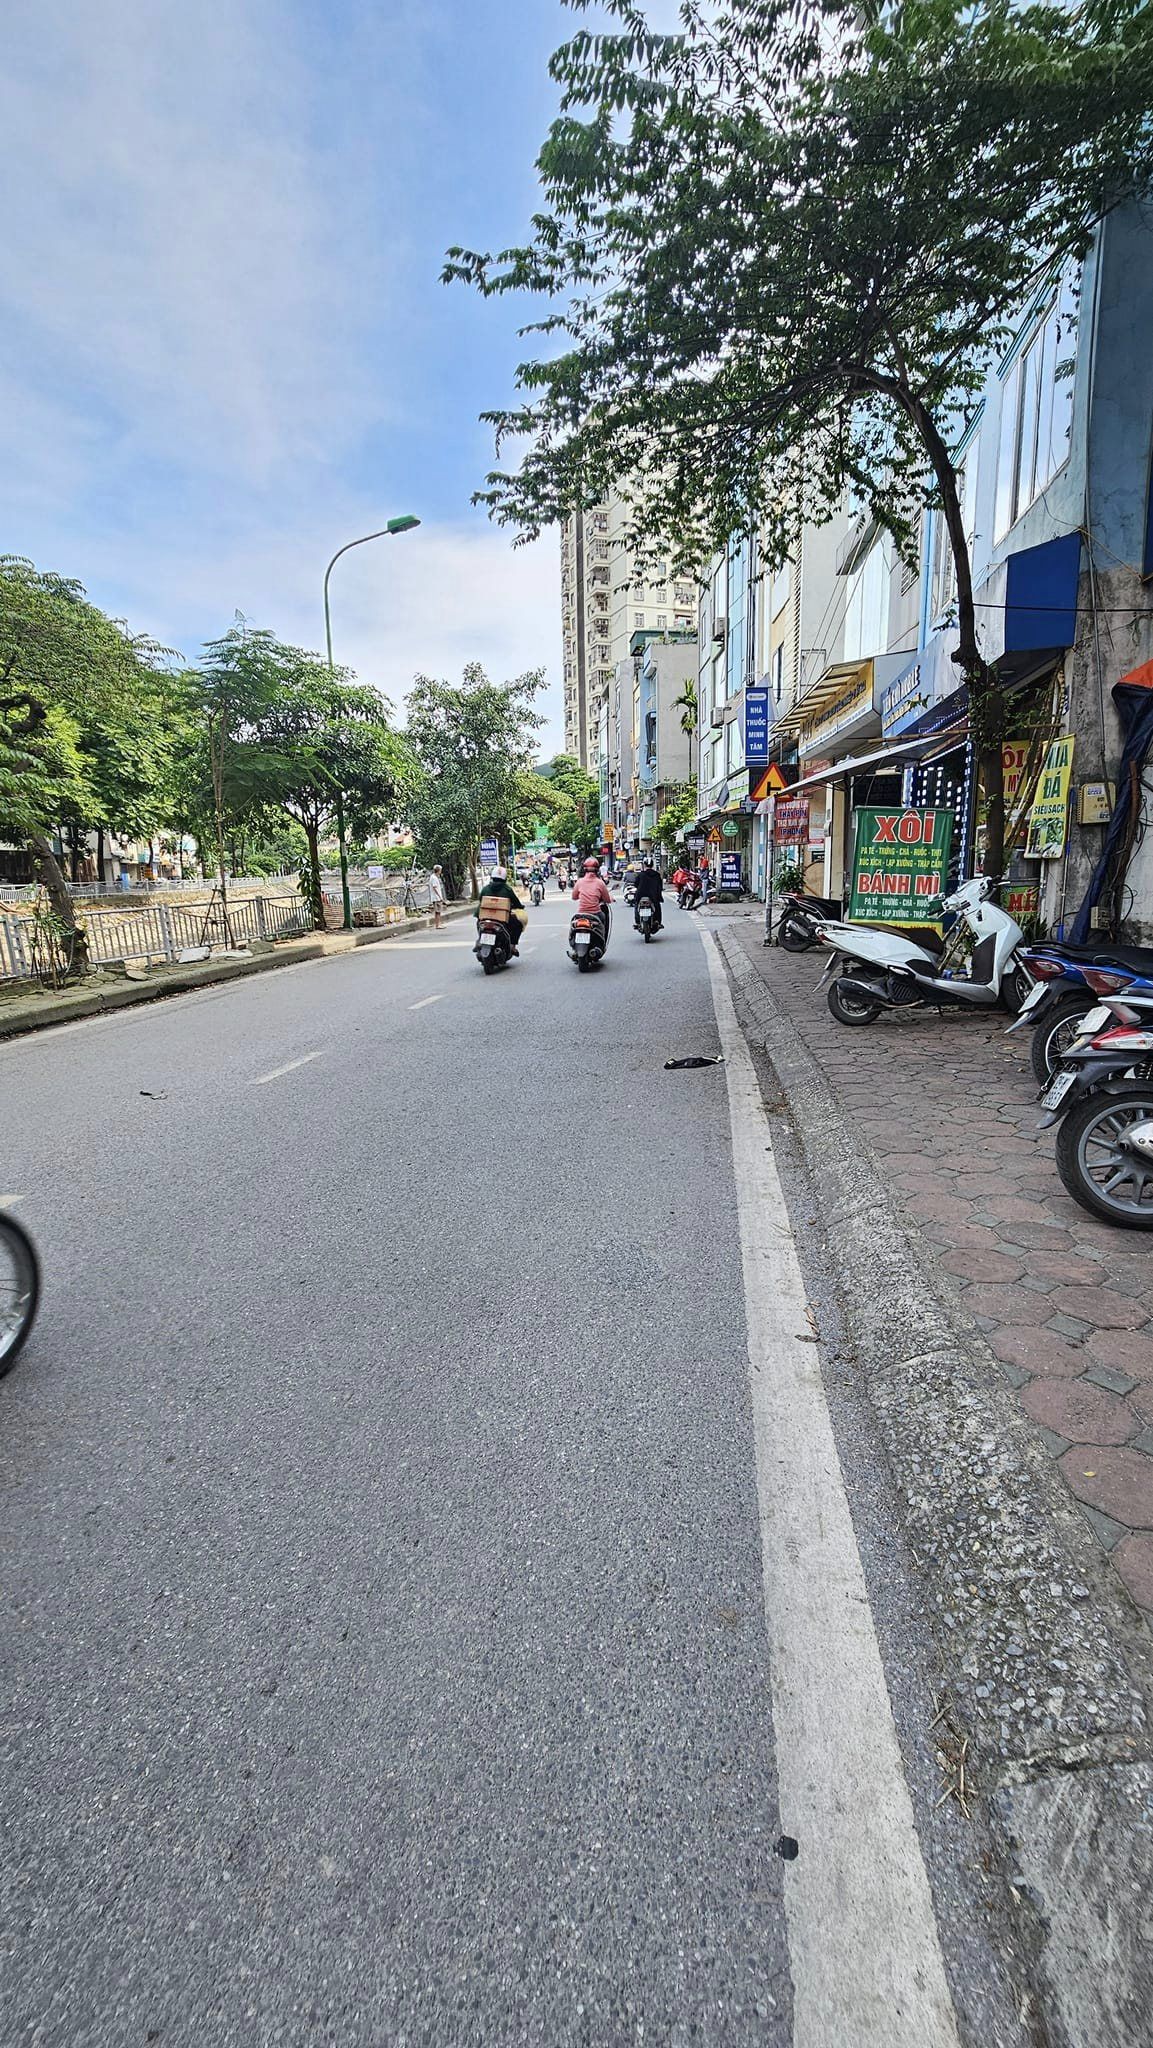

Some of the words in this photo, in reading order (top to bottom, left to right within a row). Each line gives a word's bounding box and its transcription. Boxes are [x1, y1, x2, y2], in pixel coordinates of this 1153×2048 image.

[750, 706, 763, 714] NHÀ
[872, 809, 936, 844] XÔI
[857, 869, 911, 894] BÁNH
[914, 871, 940, 896] MÌ
